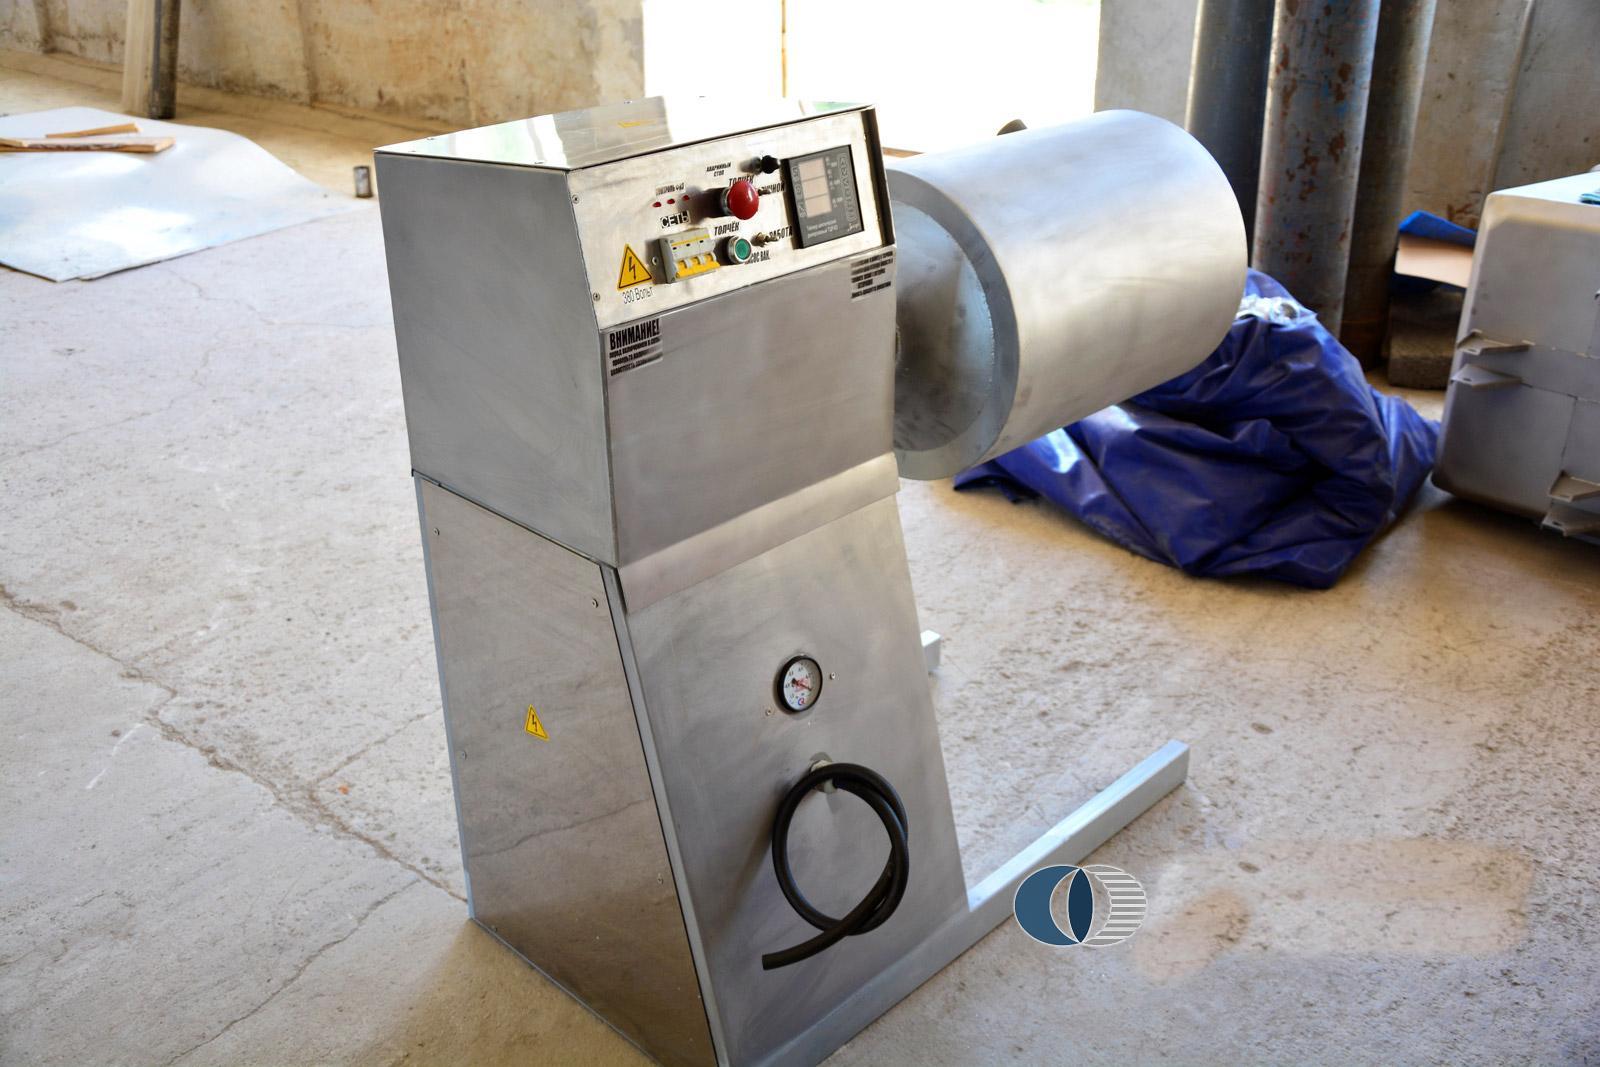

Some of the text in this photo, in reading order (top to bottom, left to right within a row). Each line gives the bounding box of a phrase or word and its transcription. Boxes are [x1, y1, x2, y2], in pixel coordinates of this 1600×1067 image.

[714, 169, 725, 177] СТОП
[661, 210, 689, 228] СЕТЬ
[714, 221, 740, 236] ТОЛЧЁК
[622, 290, 635, 304] 380
[609, 318, 660, 351] ВНИМАНИЕ!
